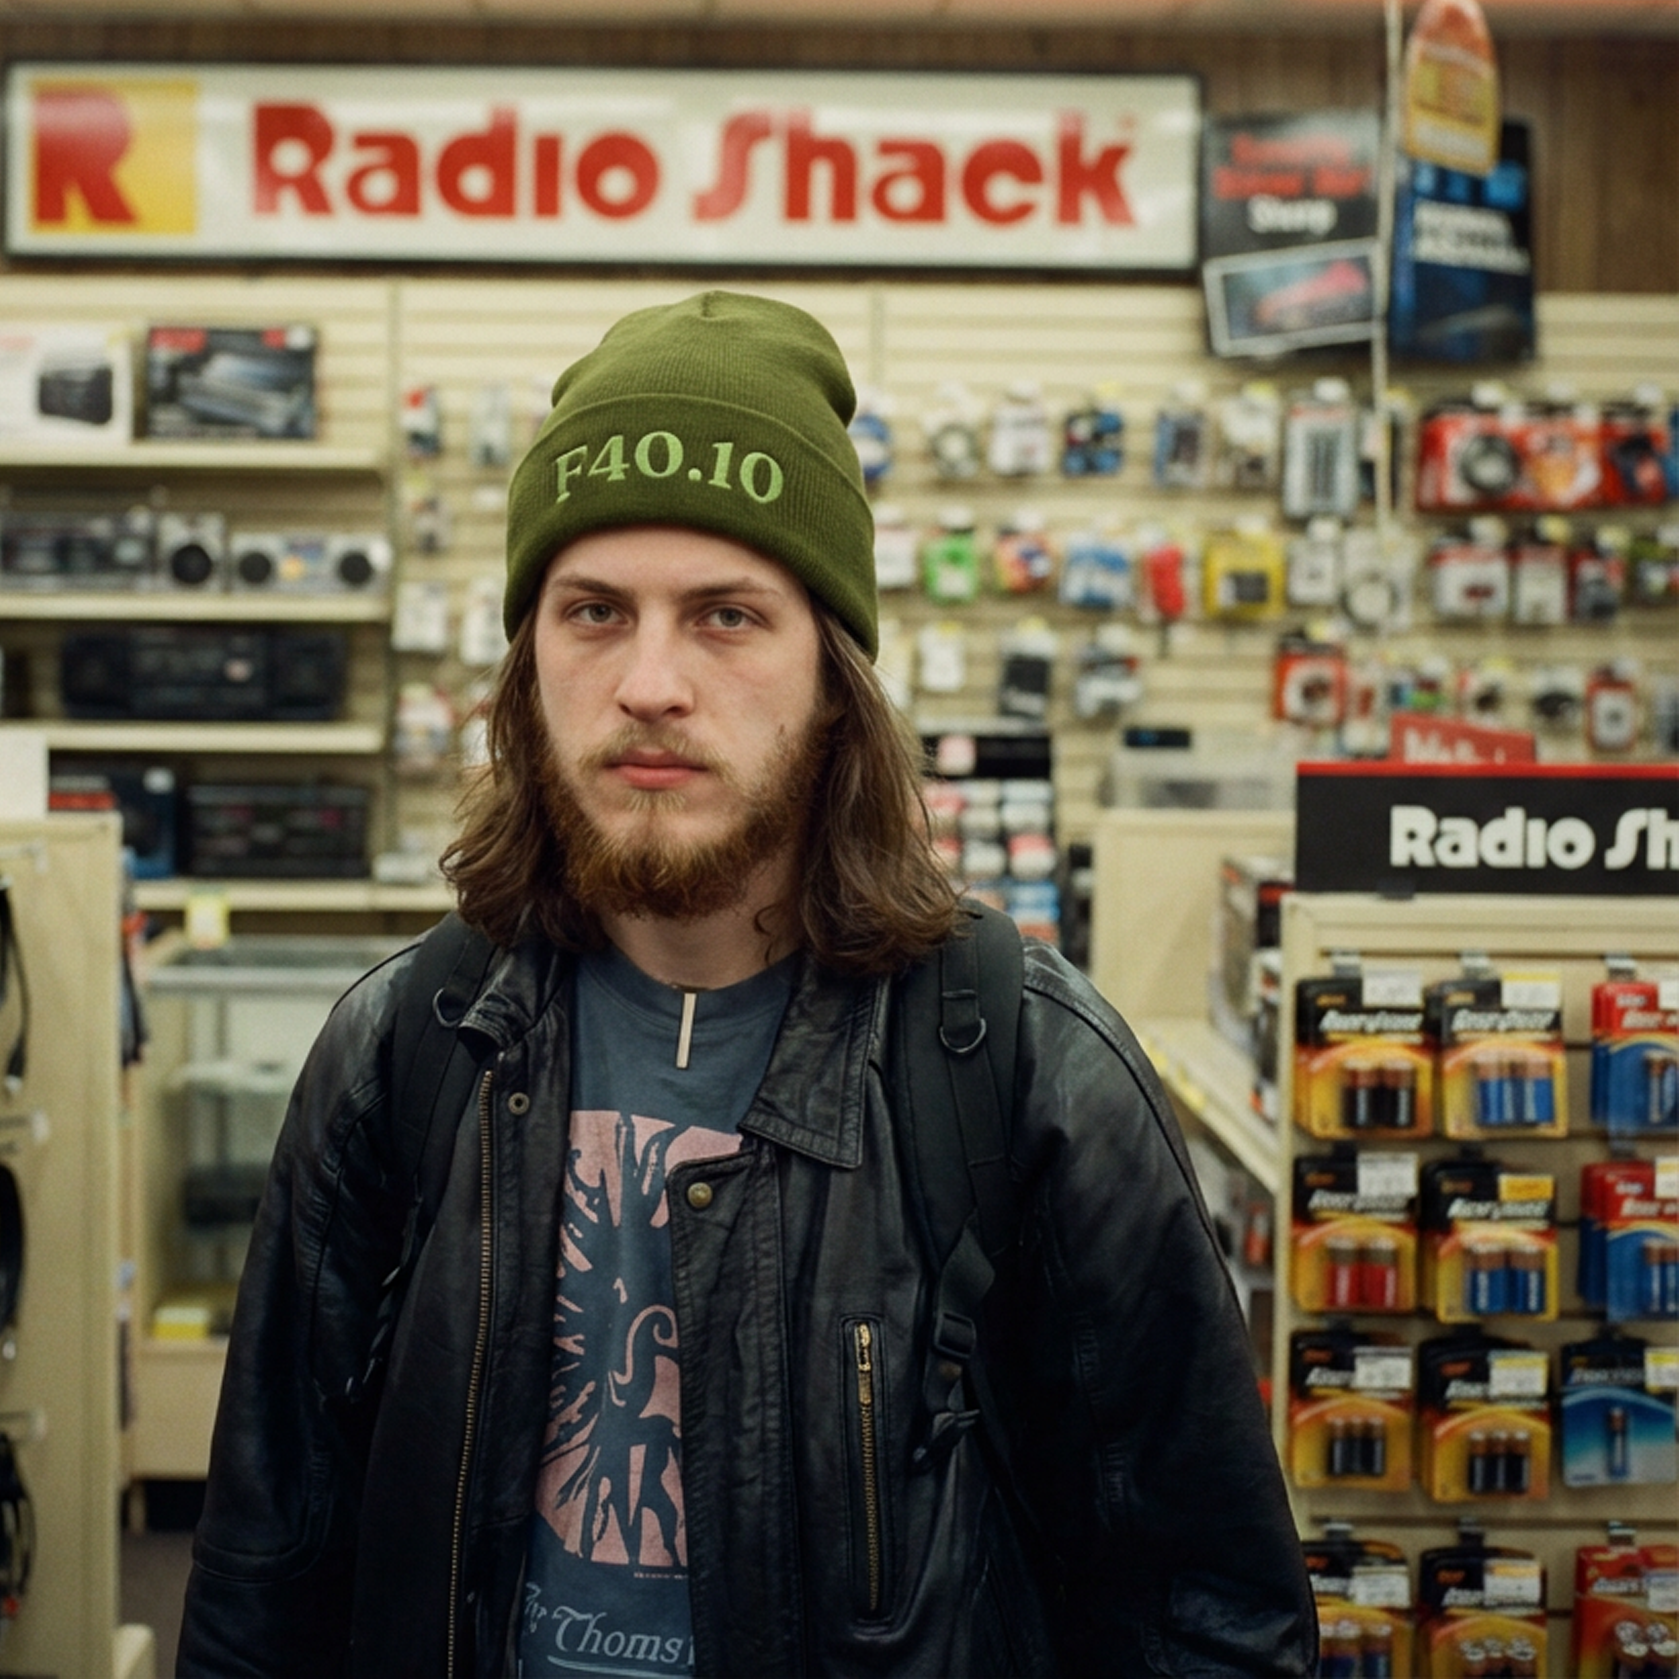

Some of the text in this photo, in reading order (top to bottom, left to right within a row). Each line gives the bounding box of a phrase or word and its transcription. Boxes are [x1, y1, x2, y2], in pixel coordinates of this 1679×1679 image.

[32, 86, 138, 226] R
[252, 101, 1137, 228] Radio Shack
[554, 431, 784, 504] F40.10
[1389, 804, 1596, 869] Radio
